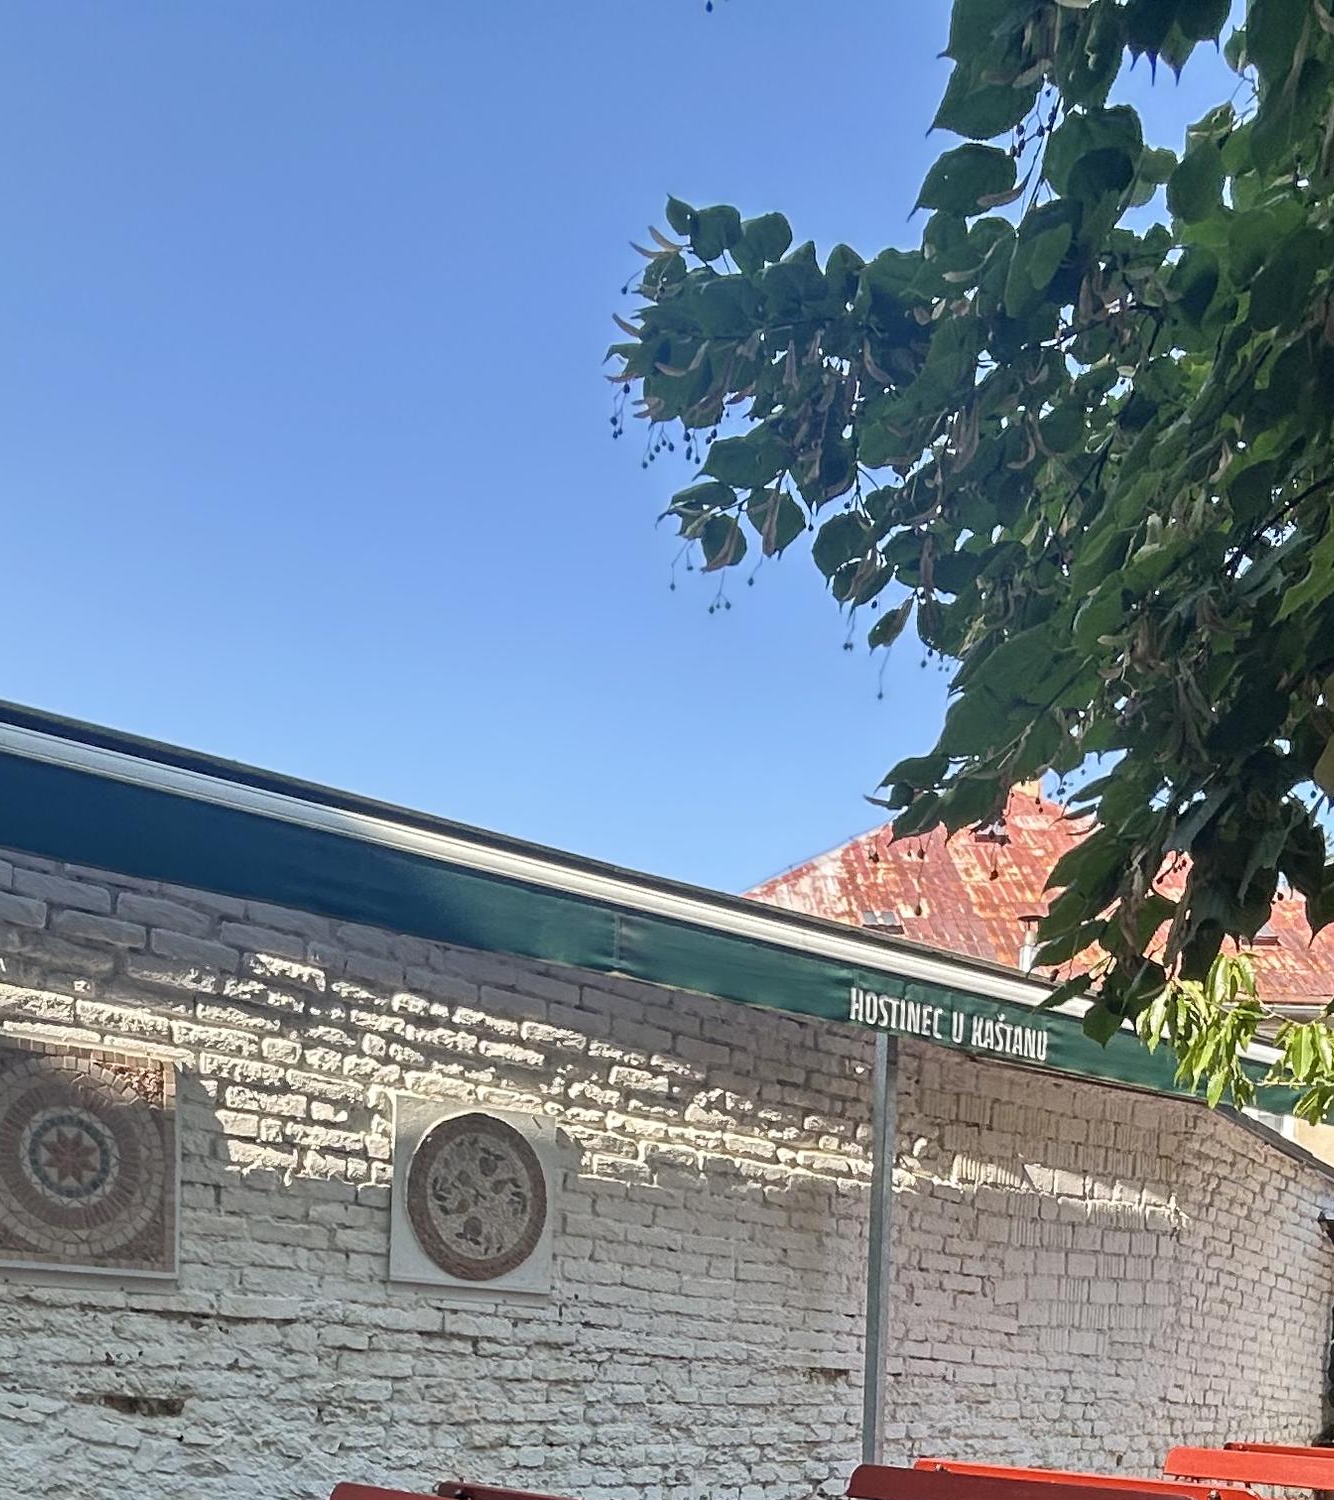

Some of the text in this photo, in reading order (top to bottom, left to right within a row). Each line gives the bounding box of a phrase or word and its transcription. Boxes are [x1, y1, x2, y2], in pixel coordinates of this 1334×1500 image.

[850, 988, 1048, 1060] HOSTINEC U KAŠTANU
